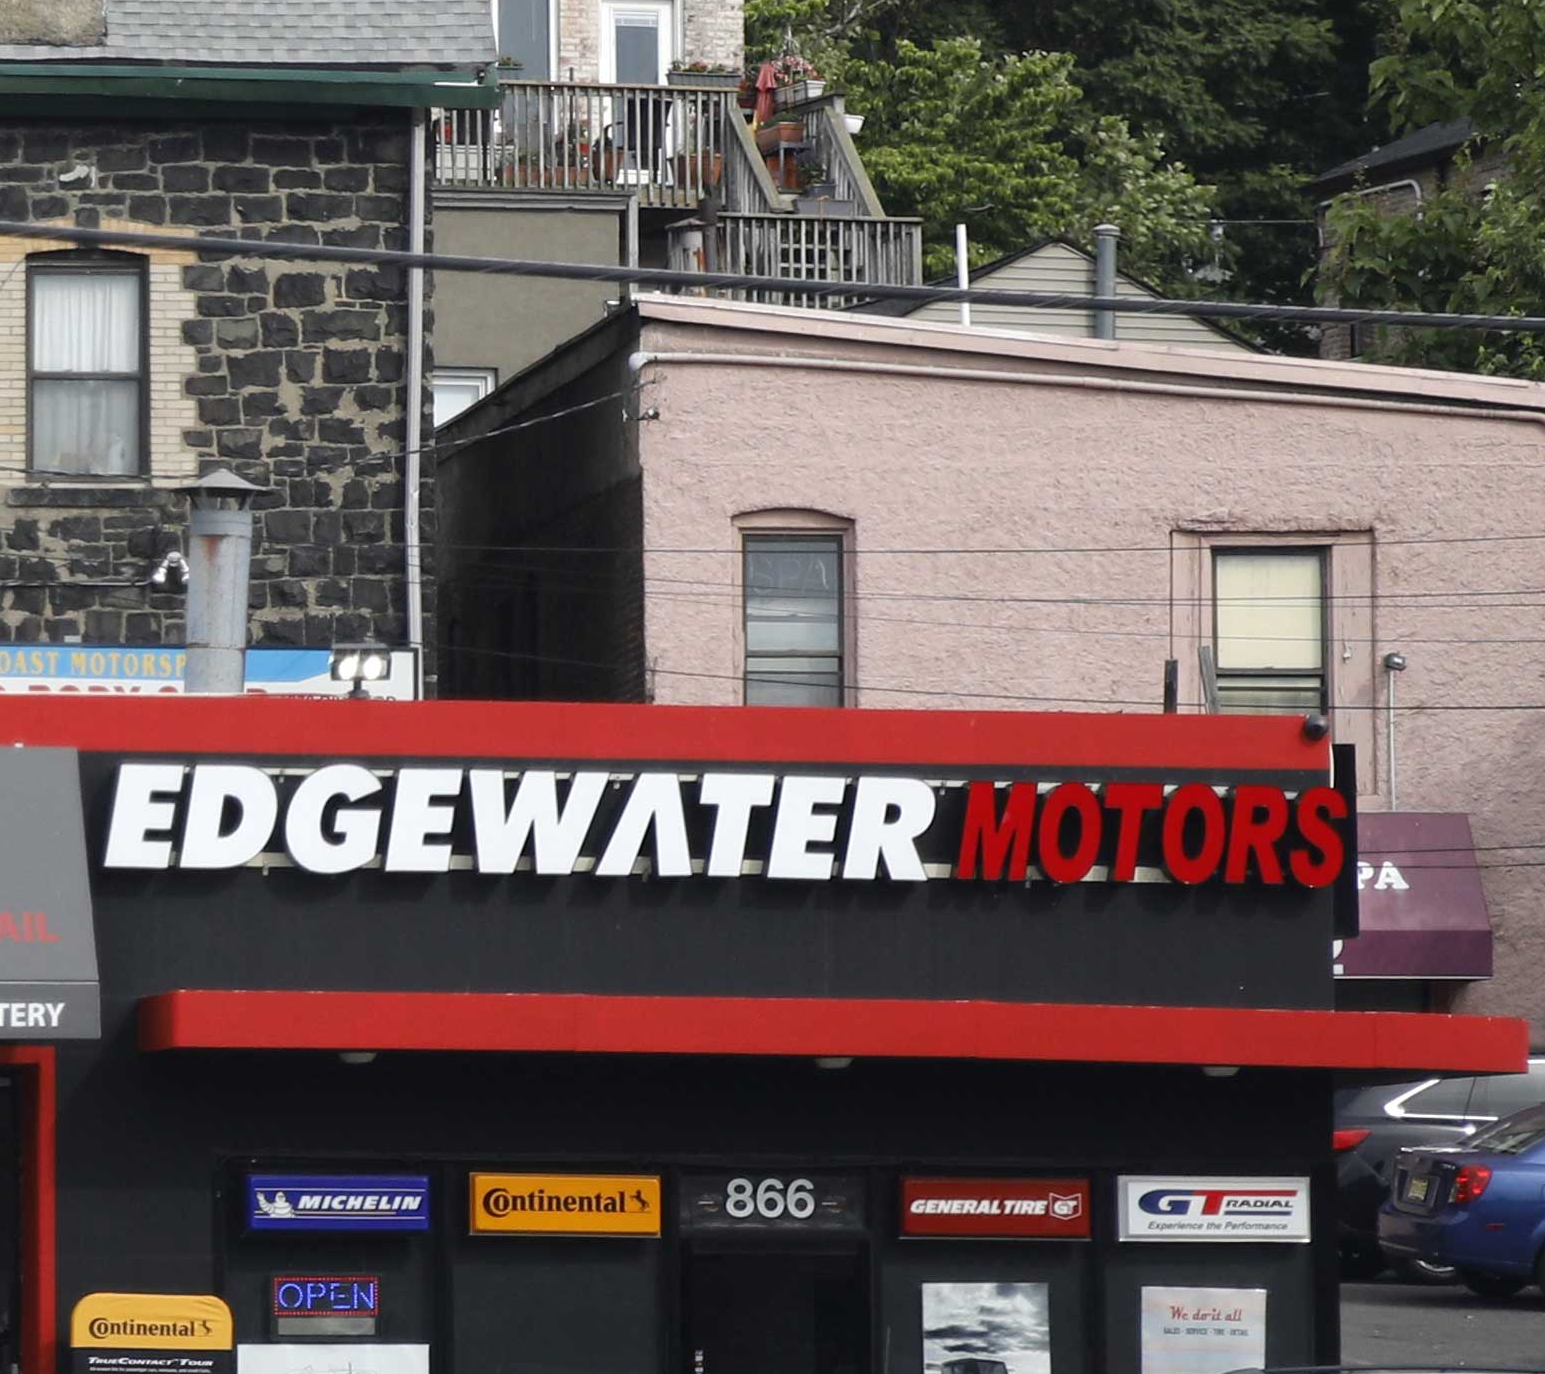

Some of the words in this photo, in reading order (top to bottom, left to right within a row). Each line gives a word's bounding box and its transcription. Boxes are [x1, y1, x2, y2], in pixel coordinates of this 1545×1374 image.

[71, 651, 187, 676] MOTORSP
[104, 763, 936, 883] EDGEWATER
[957, 780, 1349, 888] MOTORS
[297, 1194, 423, 1211] MICHELIN
[482, 1187, 627, 1218] Continental
[725, 1178, 816, 1220] 866
[910, 1199, 1000, 1215] GENERAL
[1003, 1199, 1048, 1216] TIRE
[1226, 1199, 1294, 1209] RADIAL
[1148, 1220, 1205, 1232] Experience
[1206, 1221, 1221, 1231] the
[1225, 1220, 1289, 1231] Performance
[278, 1283, 375, 1309] OPEN
[1170, 1306, 1189, 1321] We
[1225, 1308, 1243, 1322] all
[88, 1317, 195, 1339] Continental
